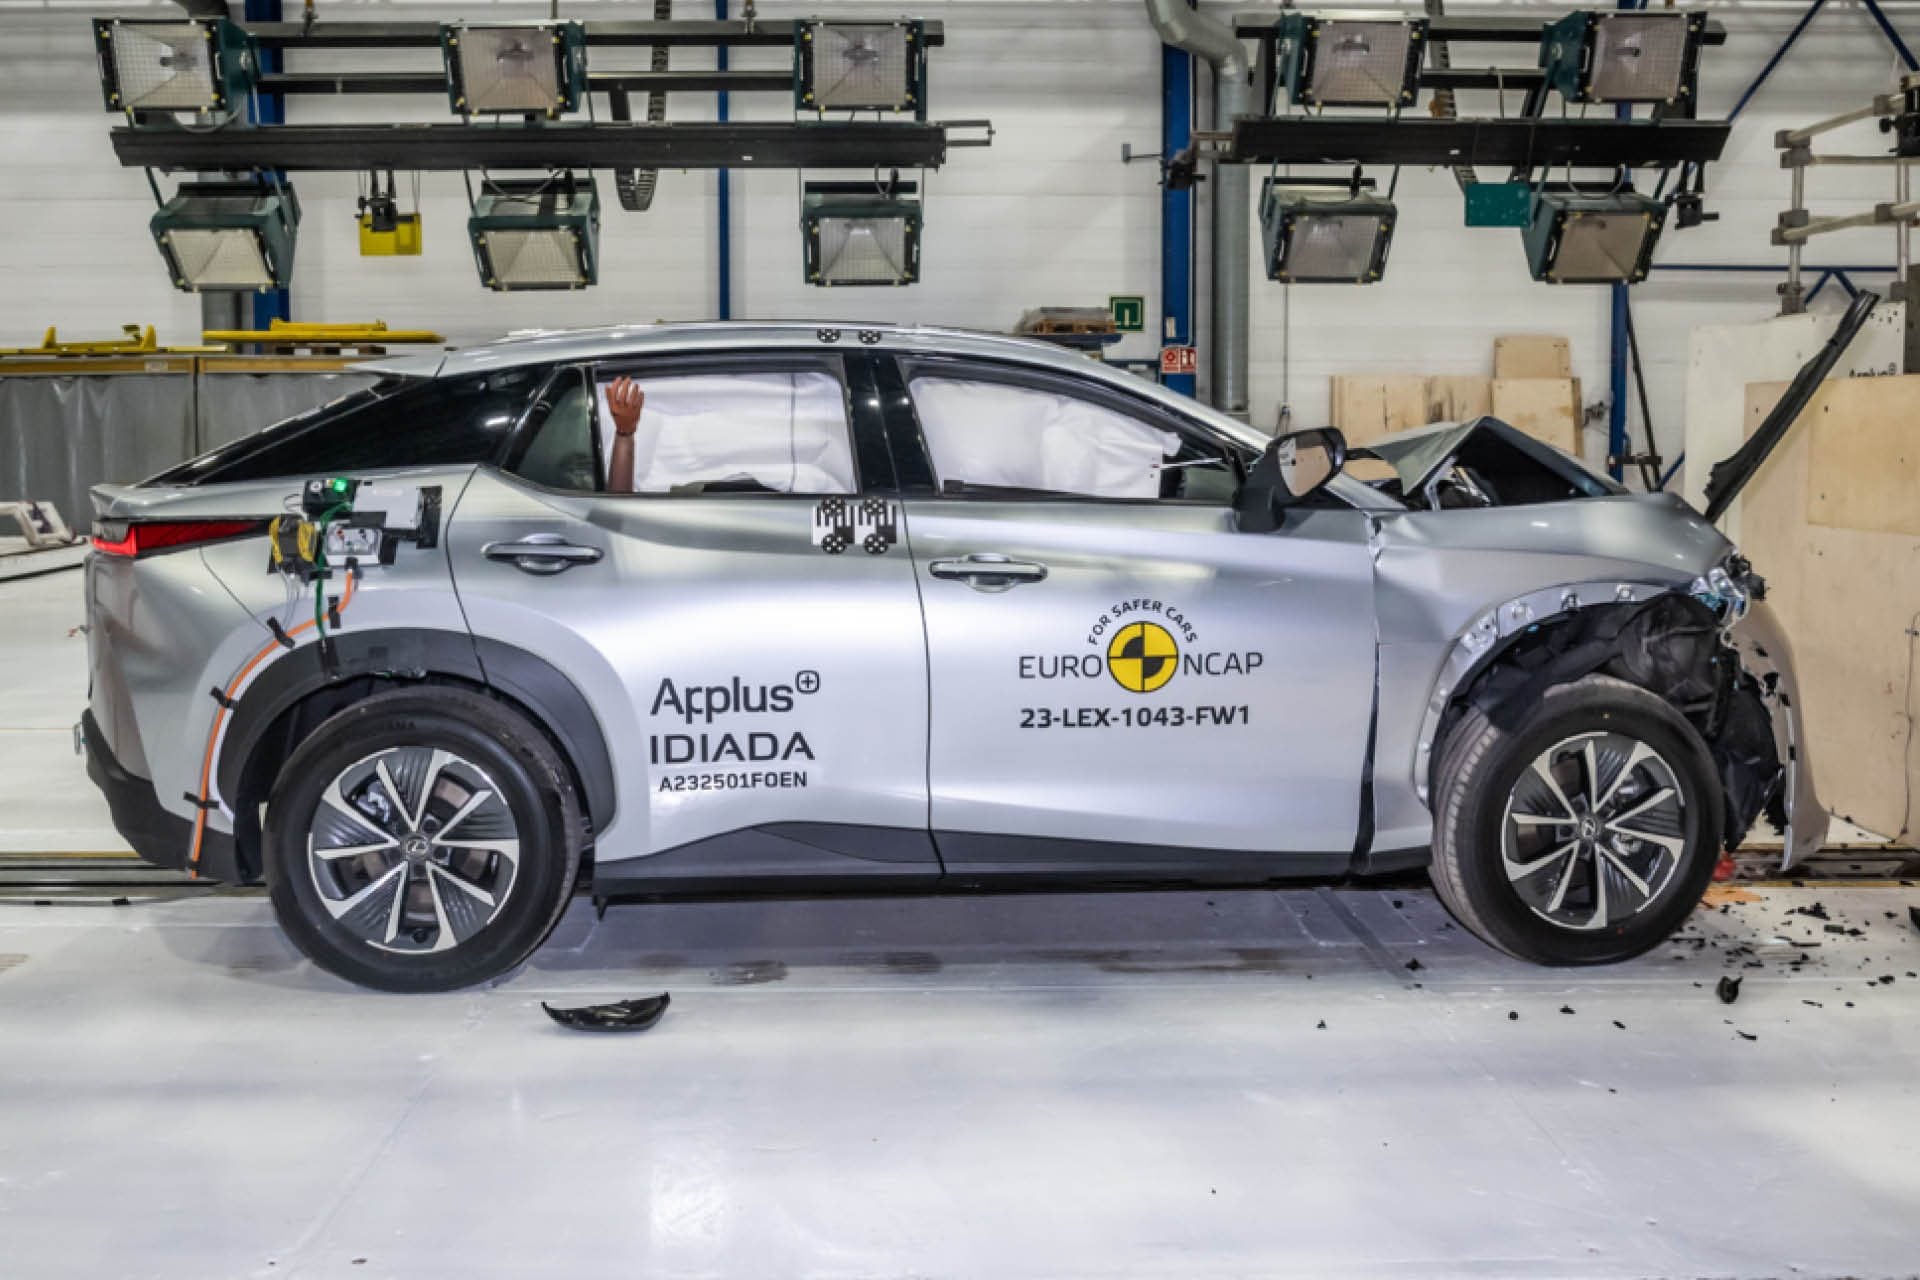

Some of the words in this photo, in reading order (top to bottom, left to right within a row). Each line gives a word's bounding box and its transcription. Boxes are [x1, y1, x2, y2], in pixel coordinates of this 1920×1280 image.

[1088, 614, 1111, 645] FOR
[1111, 599, 1162, 617] SAFER
[1166, 606, 1197, 643] CARS
[1018, 654, 1103, 679] EURO
[1183, 651, 1264, 676] NCAP
[1019, 704, 1249, 729] 23-LEX-1043-FW1
[650, 731, 816, 764] IDIADA
